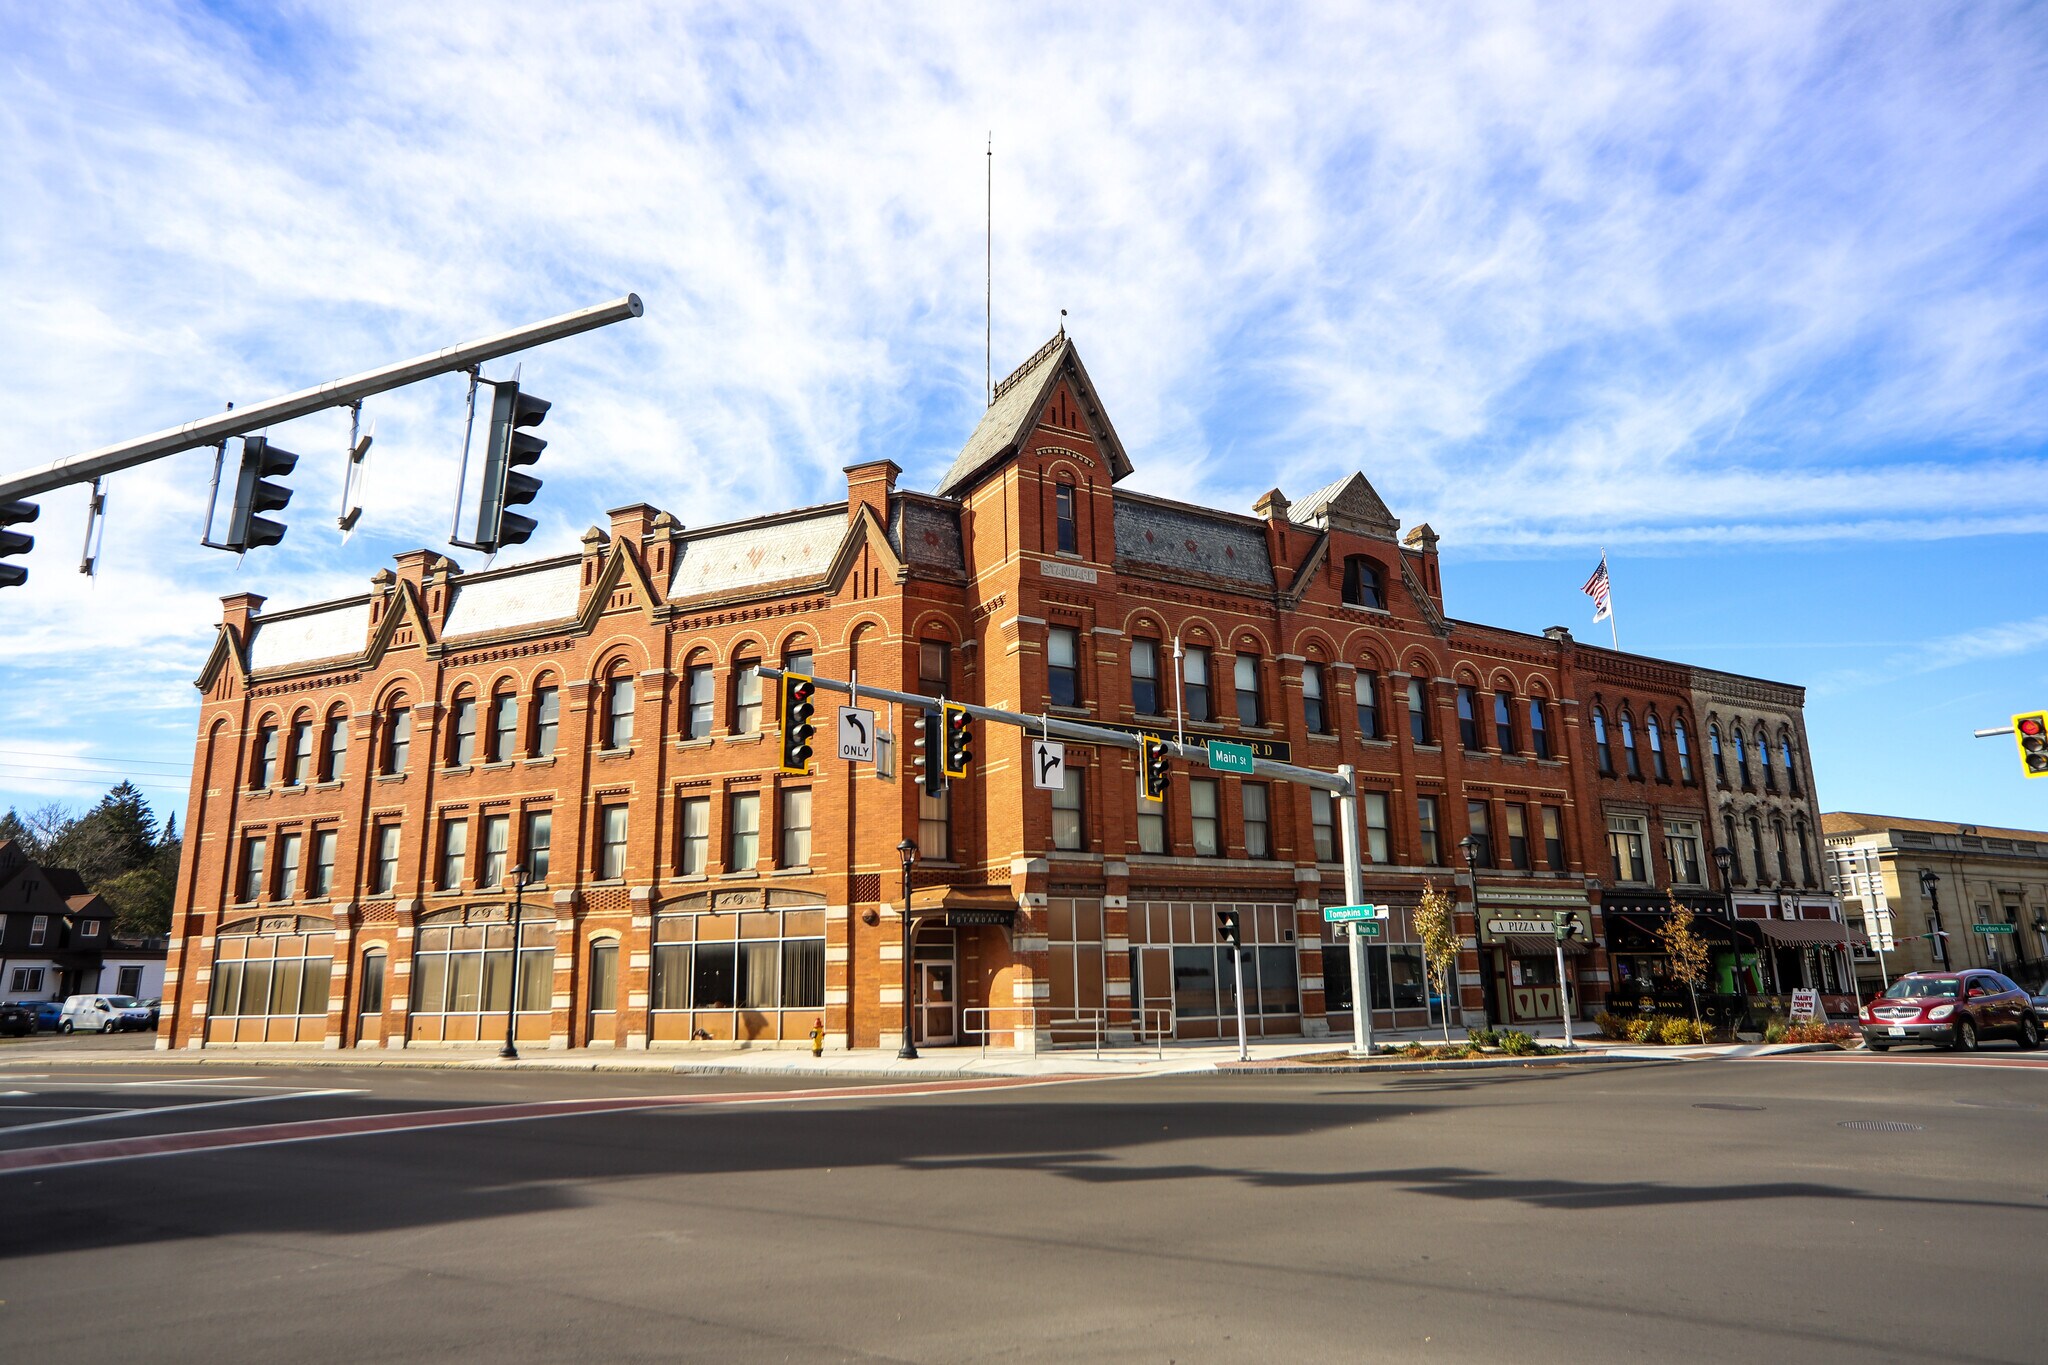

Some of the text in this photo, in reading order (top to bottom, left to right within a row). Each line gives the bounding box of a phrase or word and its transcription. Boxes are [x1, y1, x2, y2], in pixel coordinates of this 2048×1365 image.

[1042, 563, 1096, 582] STANDARD
[843, 744, 869, 757] ONLY
[1215, 749, 1247, 766] Main St
[1329, 909, 1361, 919] Tompkins
[1358, 925, 1371, 933] Main
[1498, 921, 1504, 931] A
[1508, 921, 1535, 931] PIZZA
[1540, 922, 1546, 931] &
